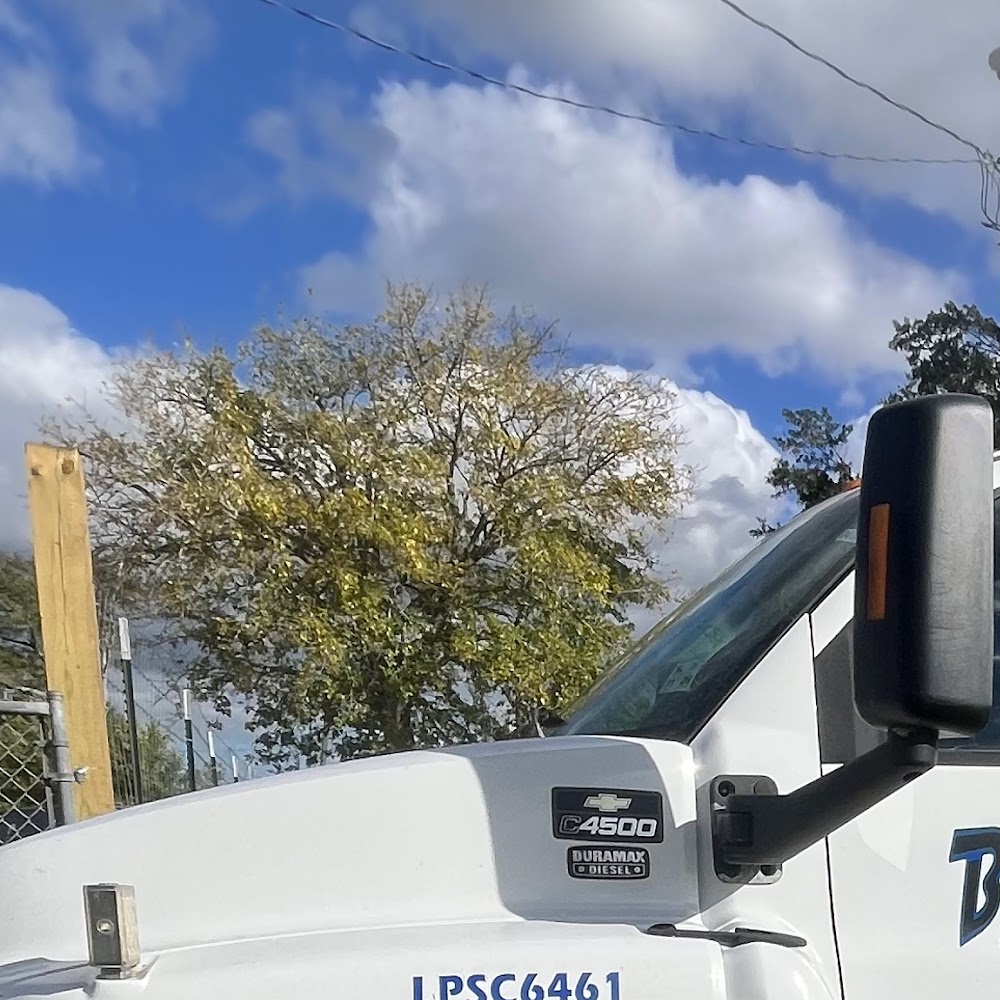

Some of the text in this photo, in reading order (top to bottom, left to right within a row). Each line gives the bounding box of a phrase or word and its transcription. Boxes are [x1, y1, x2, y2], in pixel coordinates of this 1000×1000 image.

[559, 815, 657, 837] C4500
[572, 849, 647, 863] DURAMAX
[588, 865, 631, 875] DIESEL
